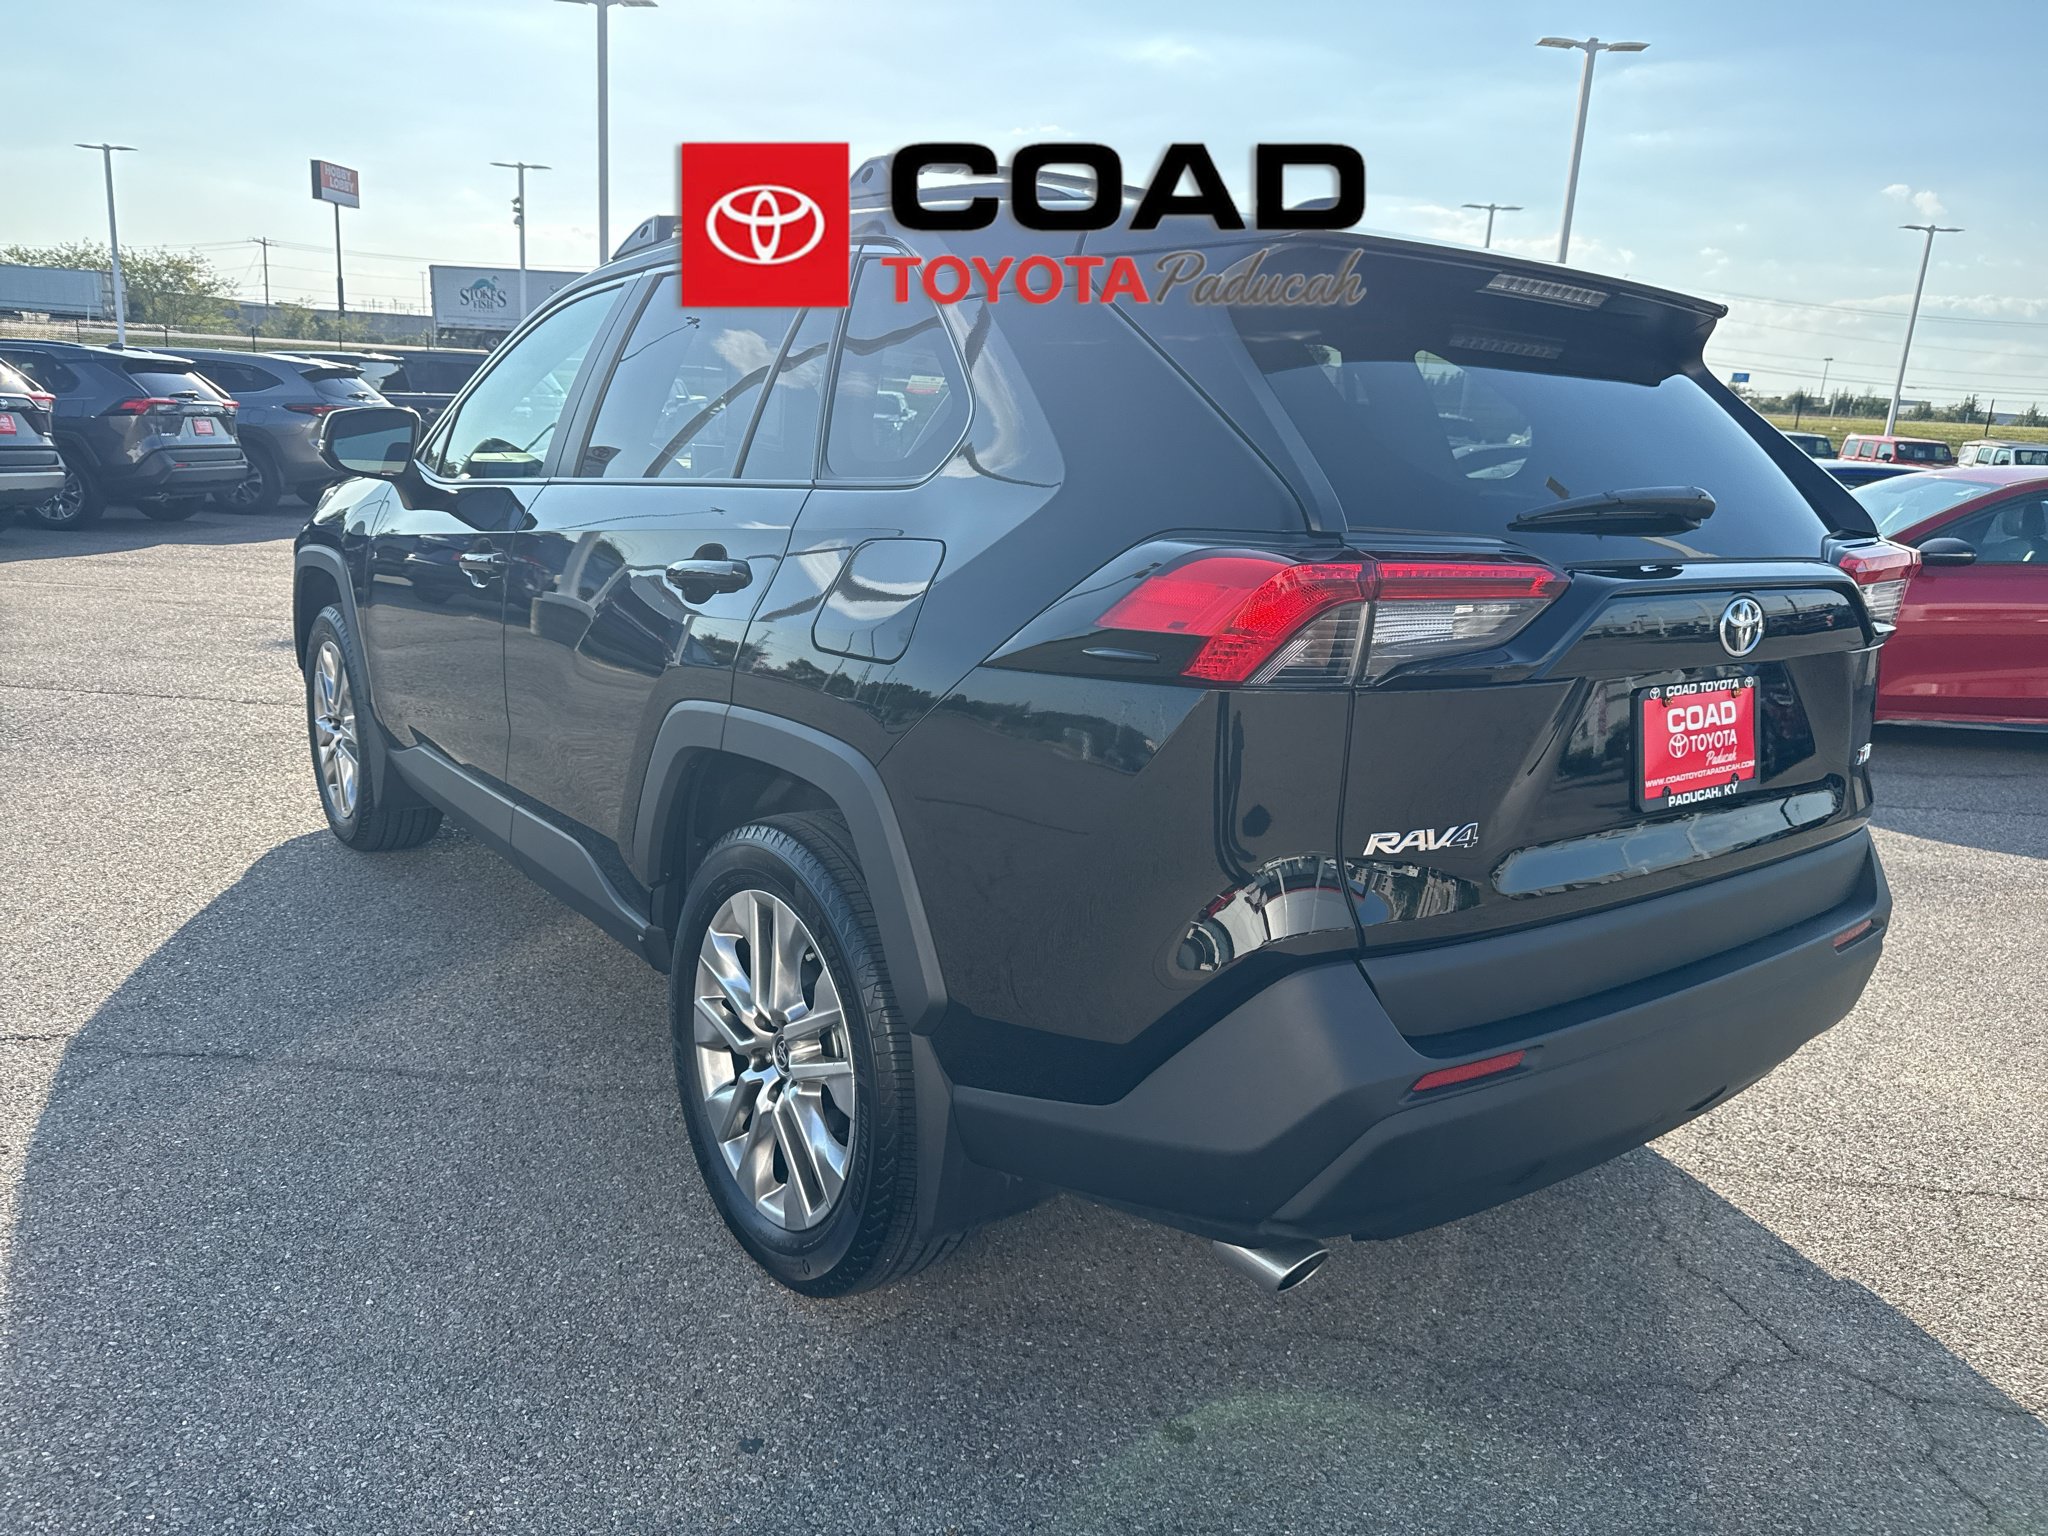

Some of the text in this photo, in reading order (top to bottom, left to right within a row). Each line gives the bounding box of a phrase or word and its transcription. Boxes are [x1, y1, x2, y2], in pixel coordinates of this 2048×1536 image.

[324, 163, 352, 183] HOBBY
[329, 176, 355, 193] LOBBY
[460, 287, 507, 308] STOKES
[473, 300, 493, 309] FISH
[1666, 678, 1740, 697] COAD TOYOTA
[1667, 701, 1737, 733] COAD
[1690, 729, 1738, 752] TOYOTA
[1705, 746, 1737, 766] Paducah
[1645, 760, 1755, 788] WWW.COADTOYOTAPADUCAH.COM
[1668, 781, 1738, 807] PADUCAH, KY
[1363, 822, 1479, 856] RAV4
